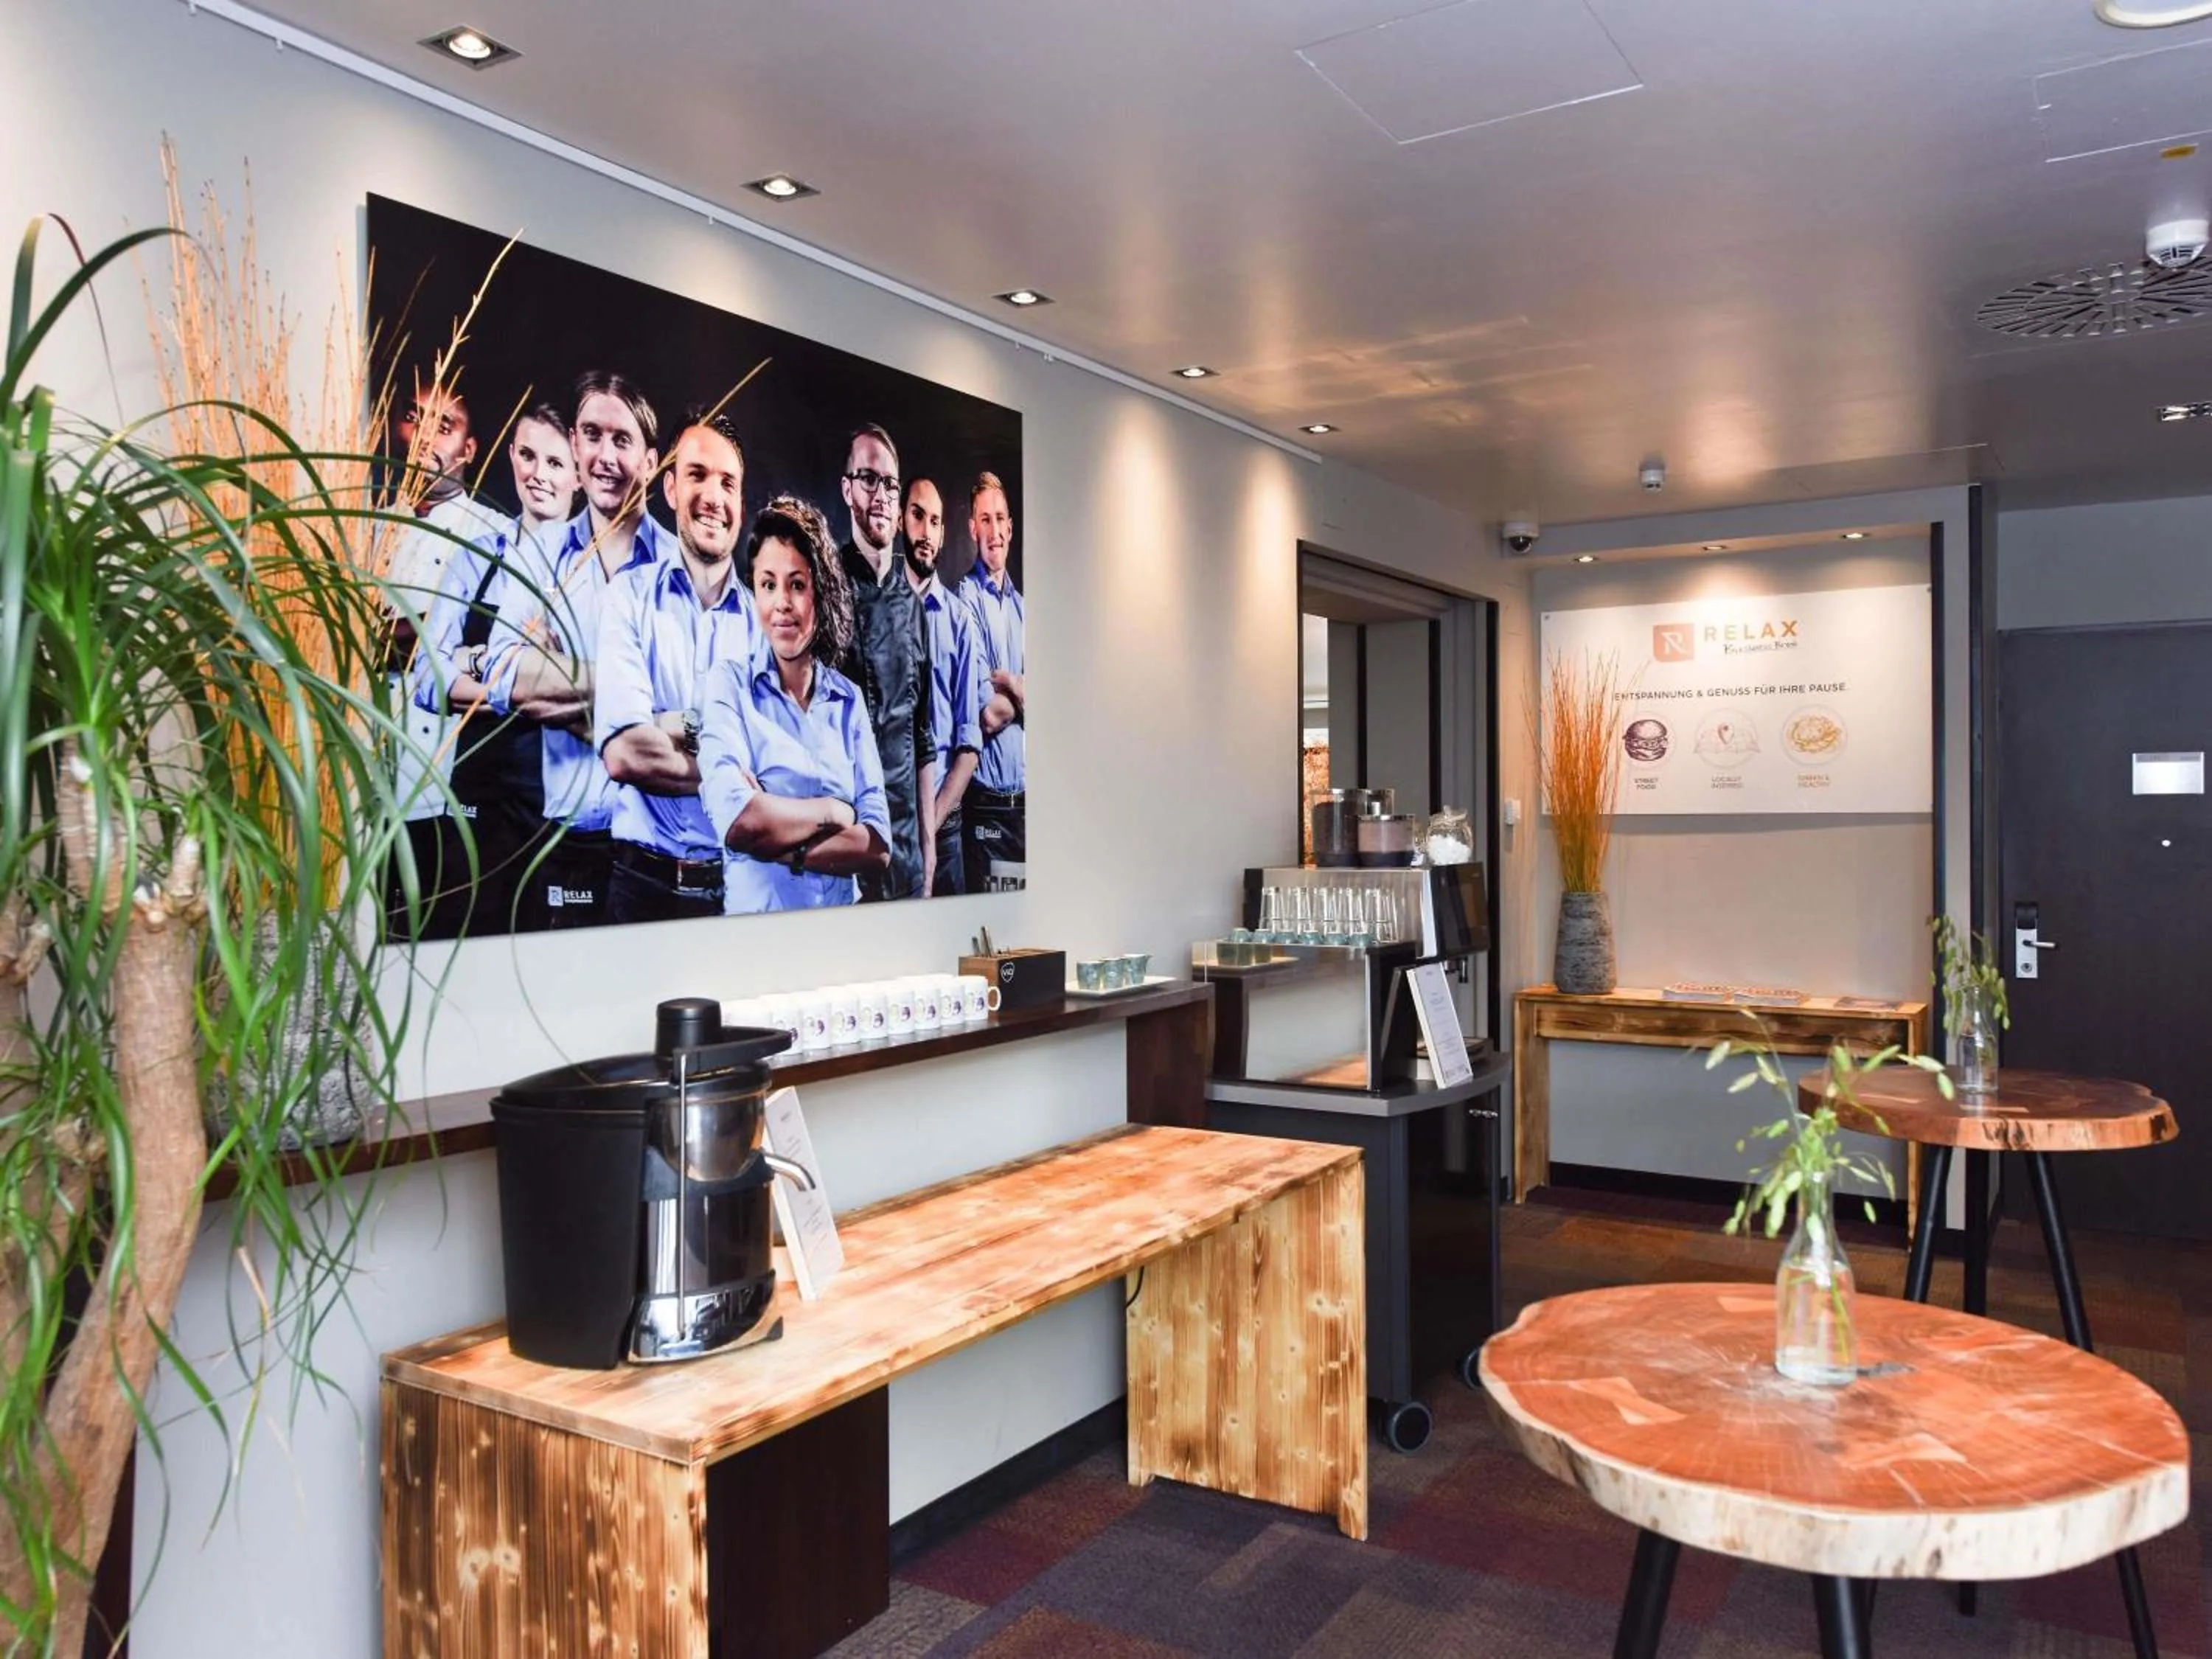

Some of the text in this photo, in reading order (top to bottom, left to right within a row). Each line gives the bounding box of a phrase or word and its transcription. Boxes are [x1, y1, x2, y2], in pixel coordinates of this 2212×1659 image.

[1704, 620, 1798, 641] RELAX
[1615, 689, 1693, 700] ENTSPANNUNG
[1707, 686, 1750, 697] GENUSS
[1754, 684, 1776, 695] FÜR
[1778, 684, 1806, 694] IHRE
[563, 890, 593, 899] RELAX
